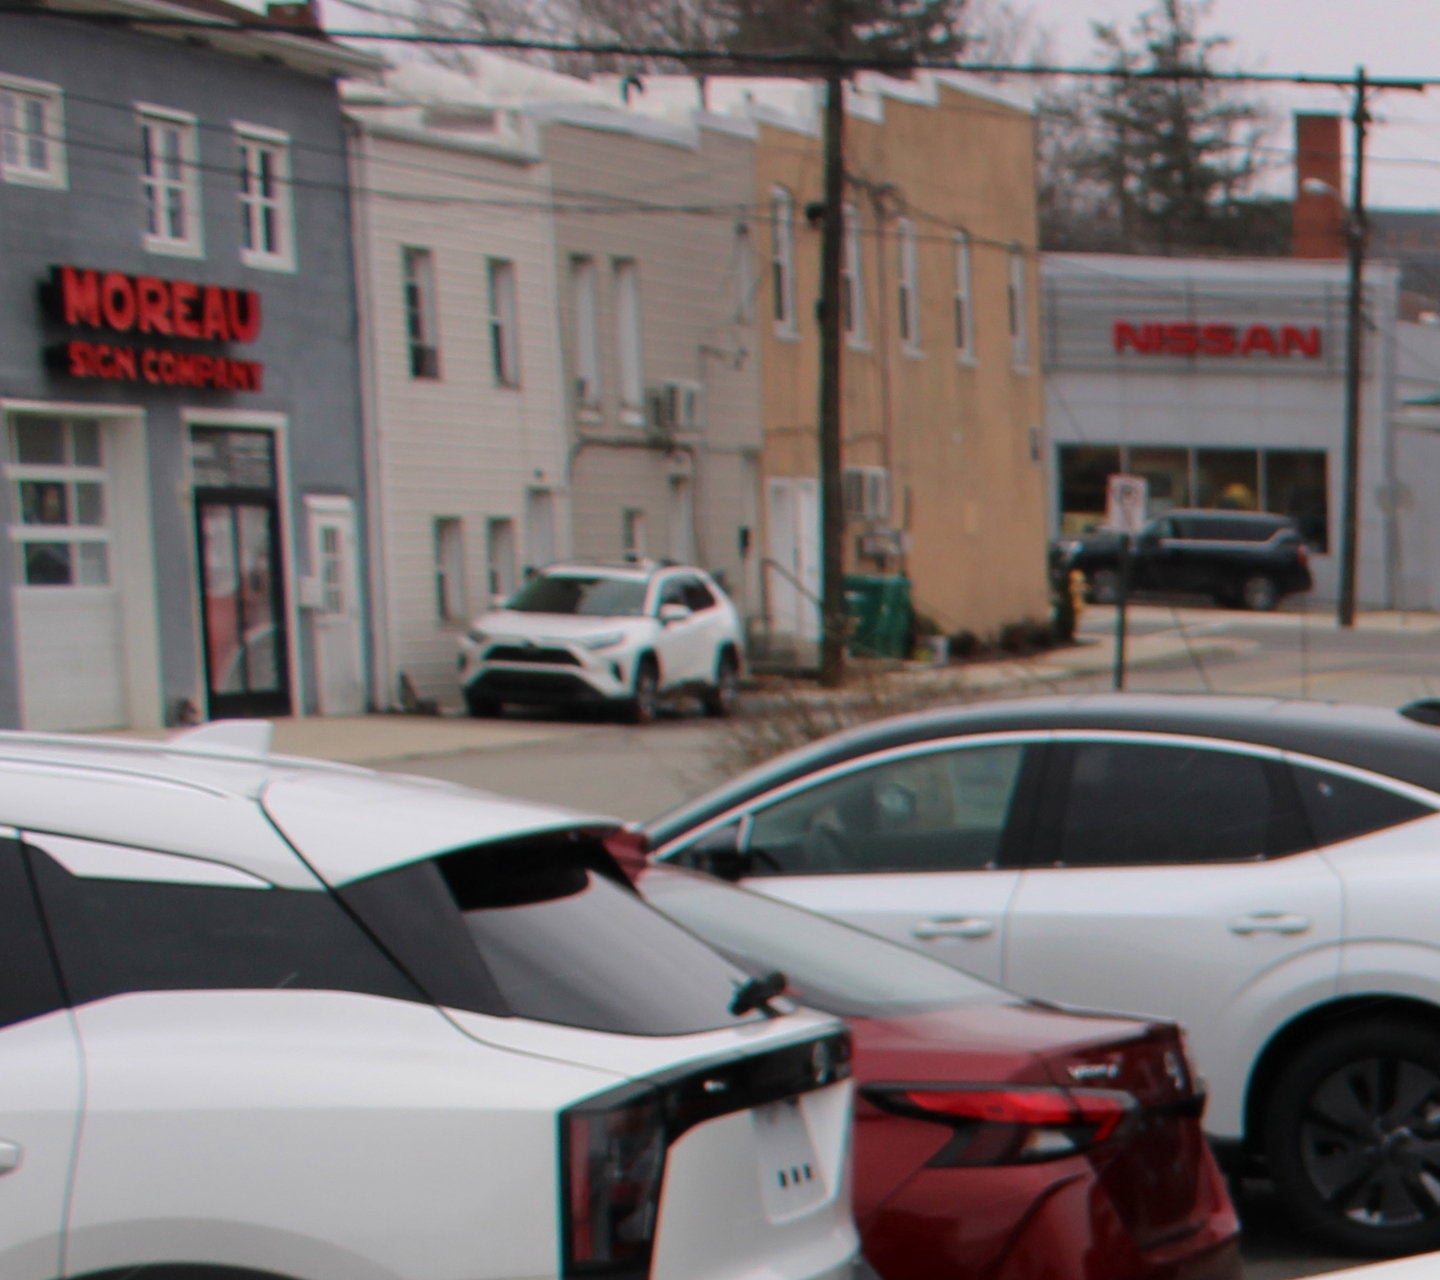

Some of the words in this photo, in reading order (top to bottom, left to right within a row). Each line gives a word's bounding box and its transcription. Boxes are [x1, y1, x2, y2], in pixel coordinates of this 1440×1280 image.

[61, 264, 261, 344] MOREAU
[1113, 318, 1322, 359] NISSAN
[67, 340, 137, 381] SIGN
[140, 347, 264, 394] COMPANY
